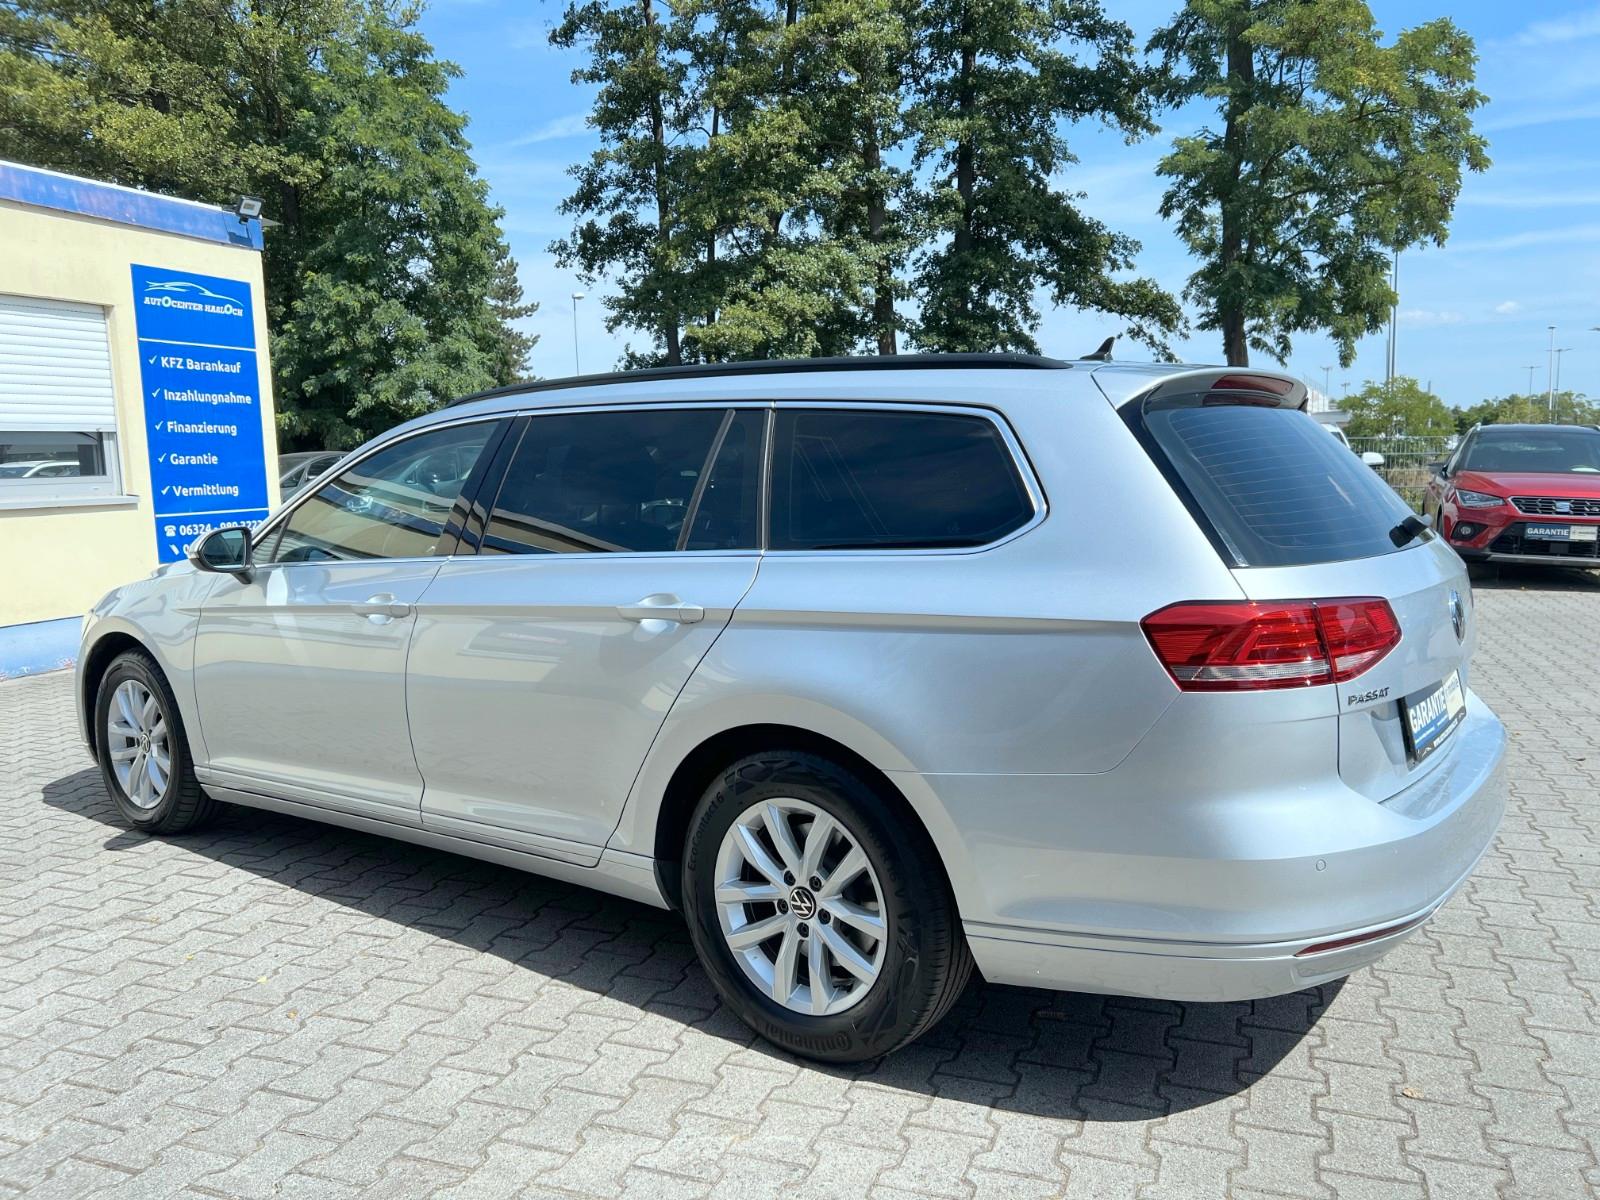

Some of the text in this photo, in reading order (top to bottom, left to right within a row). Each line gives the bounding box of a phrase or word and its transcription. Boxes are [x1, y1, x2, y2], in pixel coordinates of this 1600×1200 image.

[144, 296, 203, 312] AUTOCENTER
[161, 356, 241, 374] KFZ Barankauf
[163, 388, 252, 405] Inzahlungnahme
[167, 421, 238, 436] Finanzierung
[170, 453, 218, 465] Garantie
[172, 483, 239, 497] Vermittlung
[179, 523, 211, 536] 06324
[1527, 527, 1569, 536] GARANTIE
[1348, 687, 1389, 706] PASSAT
[1409, 687, 1447, 734] GARANTIE
[687, 799, 719, 872] EcoContact
